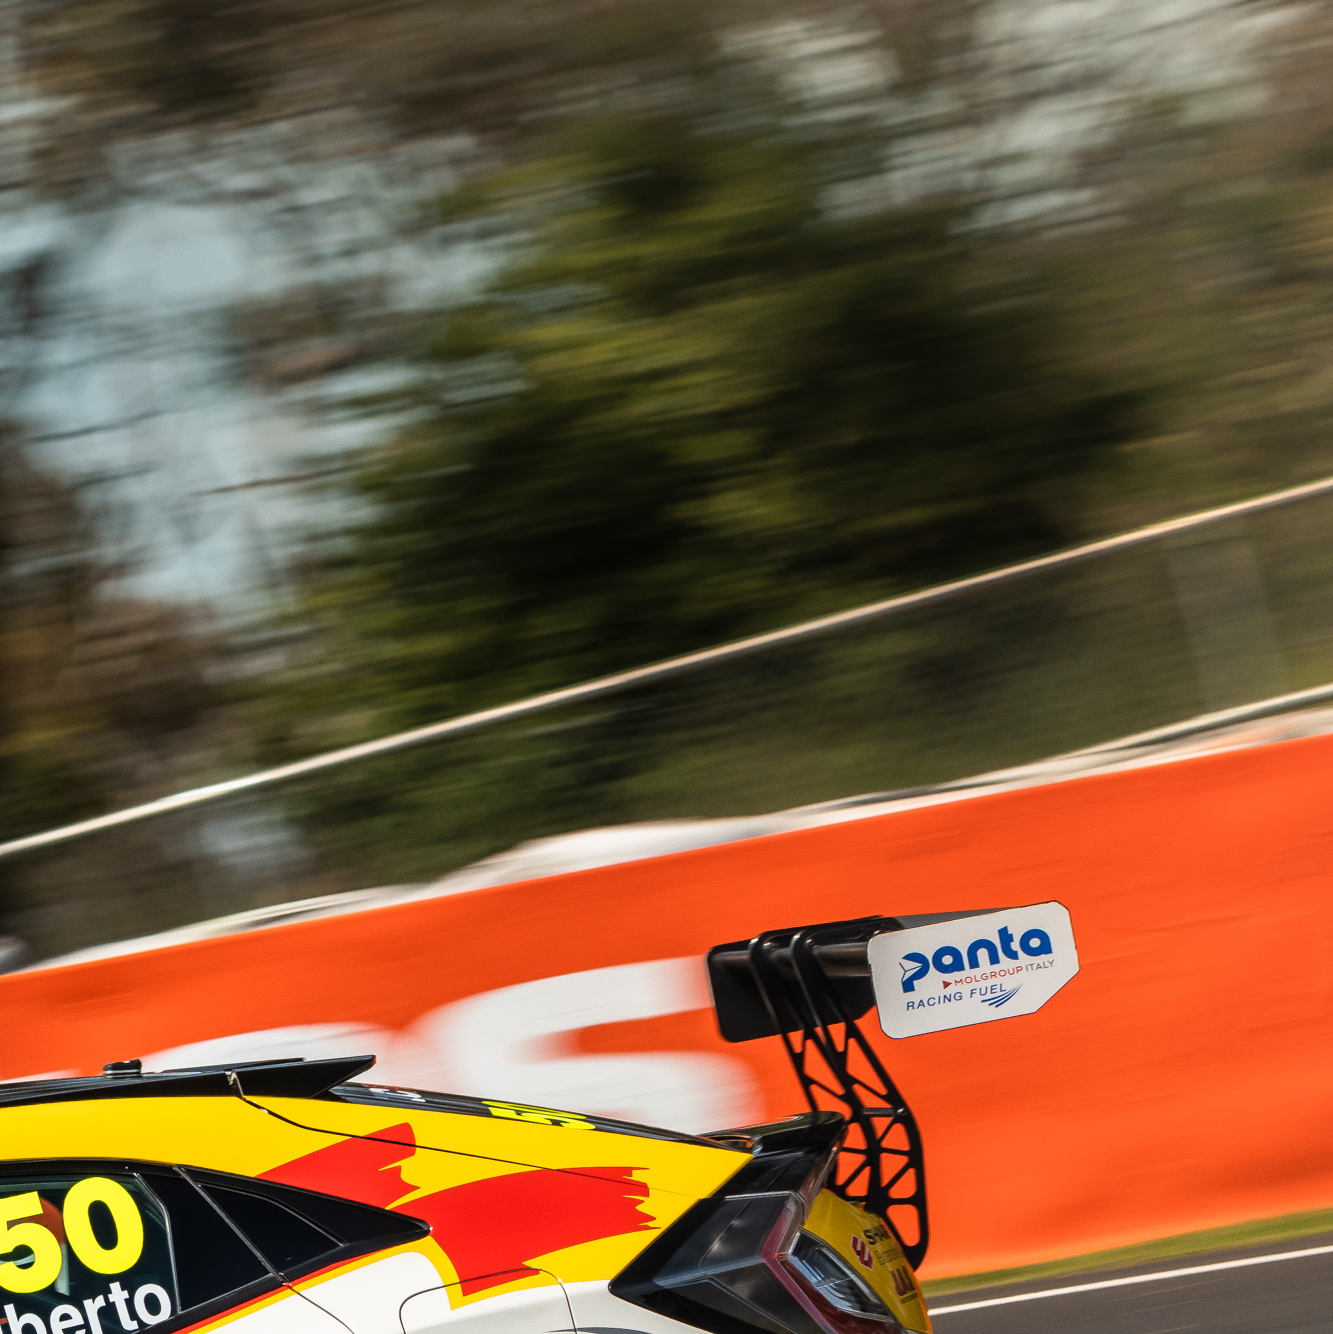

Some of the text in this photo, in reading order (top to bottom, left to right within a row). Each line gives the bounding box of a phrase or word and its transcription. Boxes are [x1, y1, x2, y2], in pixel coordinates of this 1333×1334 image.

[899, 925, 1053, 993] panta
[906, 983, 1007, 1011] RACING FUEL
